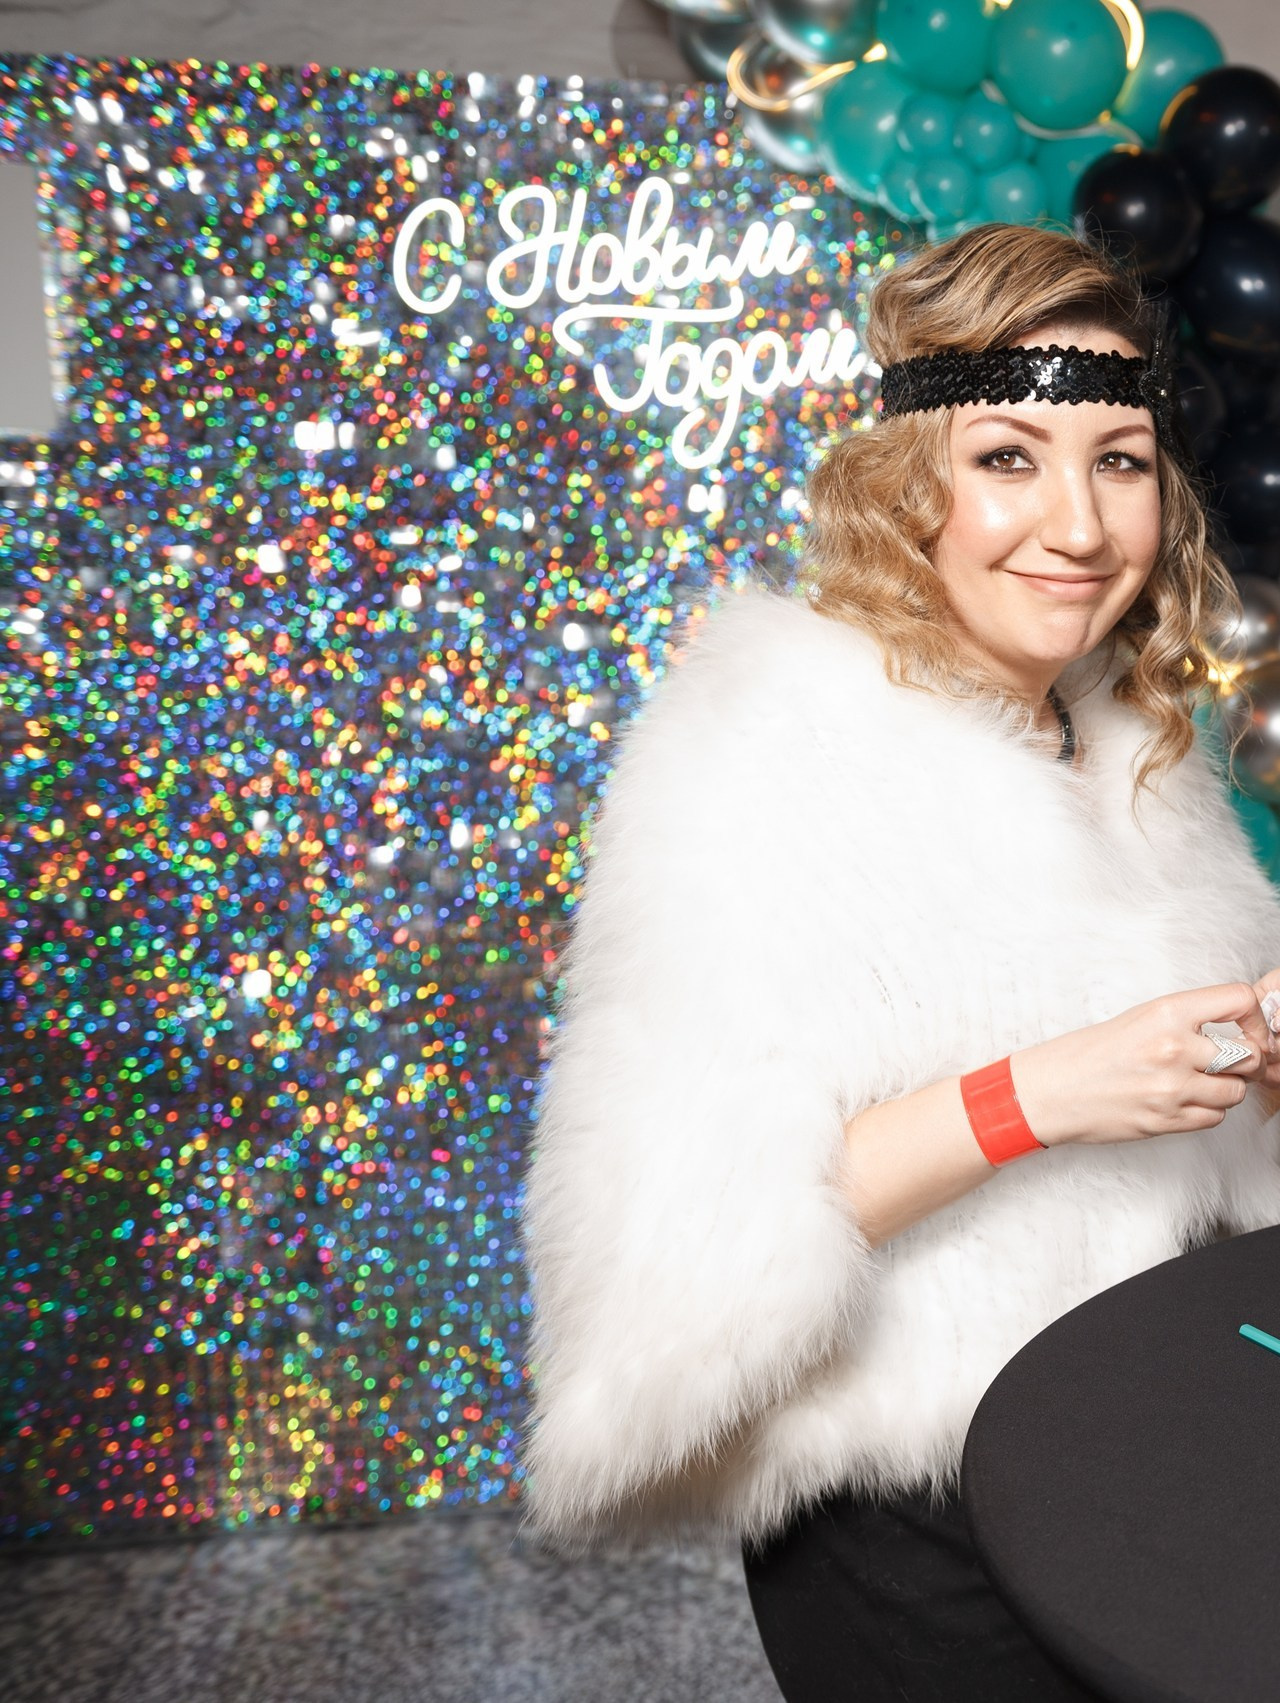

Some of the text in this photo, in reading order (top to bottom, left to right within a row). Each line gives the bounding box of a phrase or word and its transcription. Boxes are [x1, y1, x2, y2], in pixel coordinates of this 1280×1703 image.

[393, 176, 811, 315] С Новым
[552, 286, 868, 469] Годом
